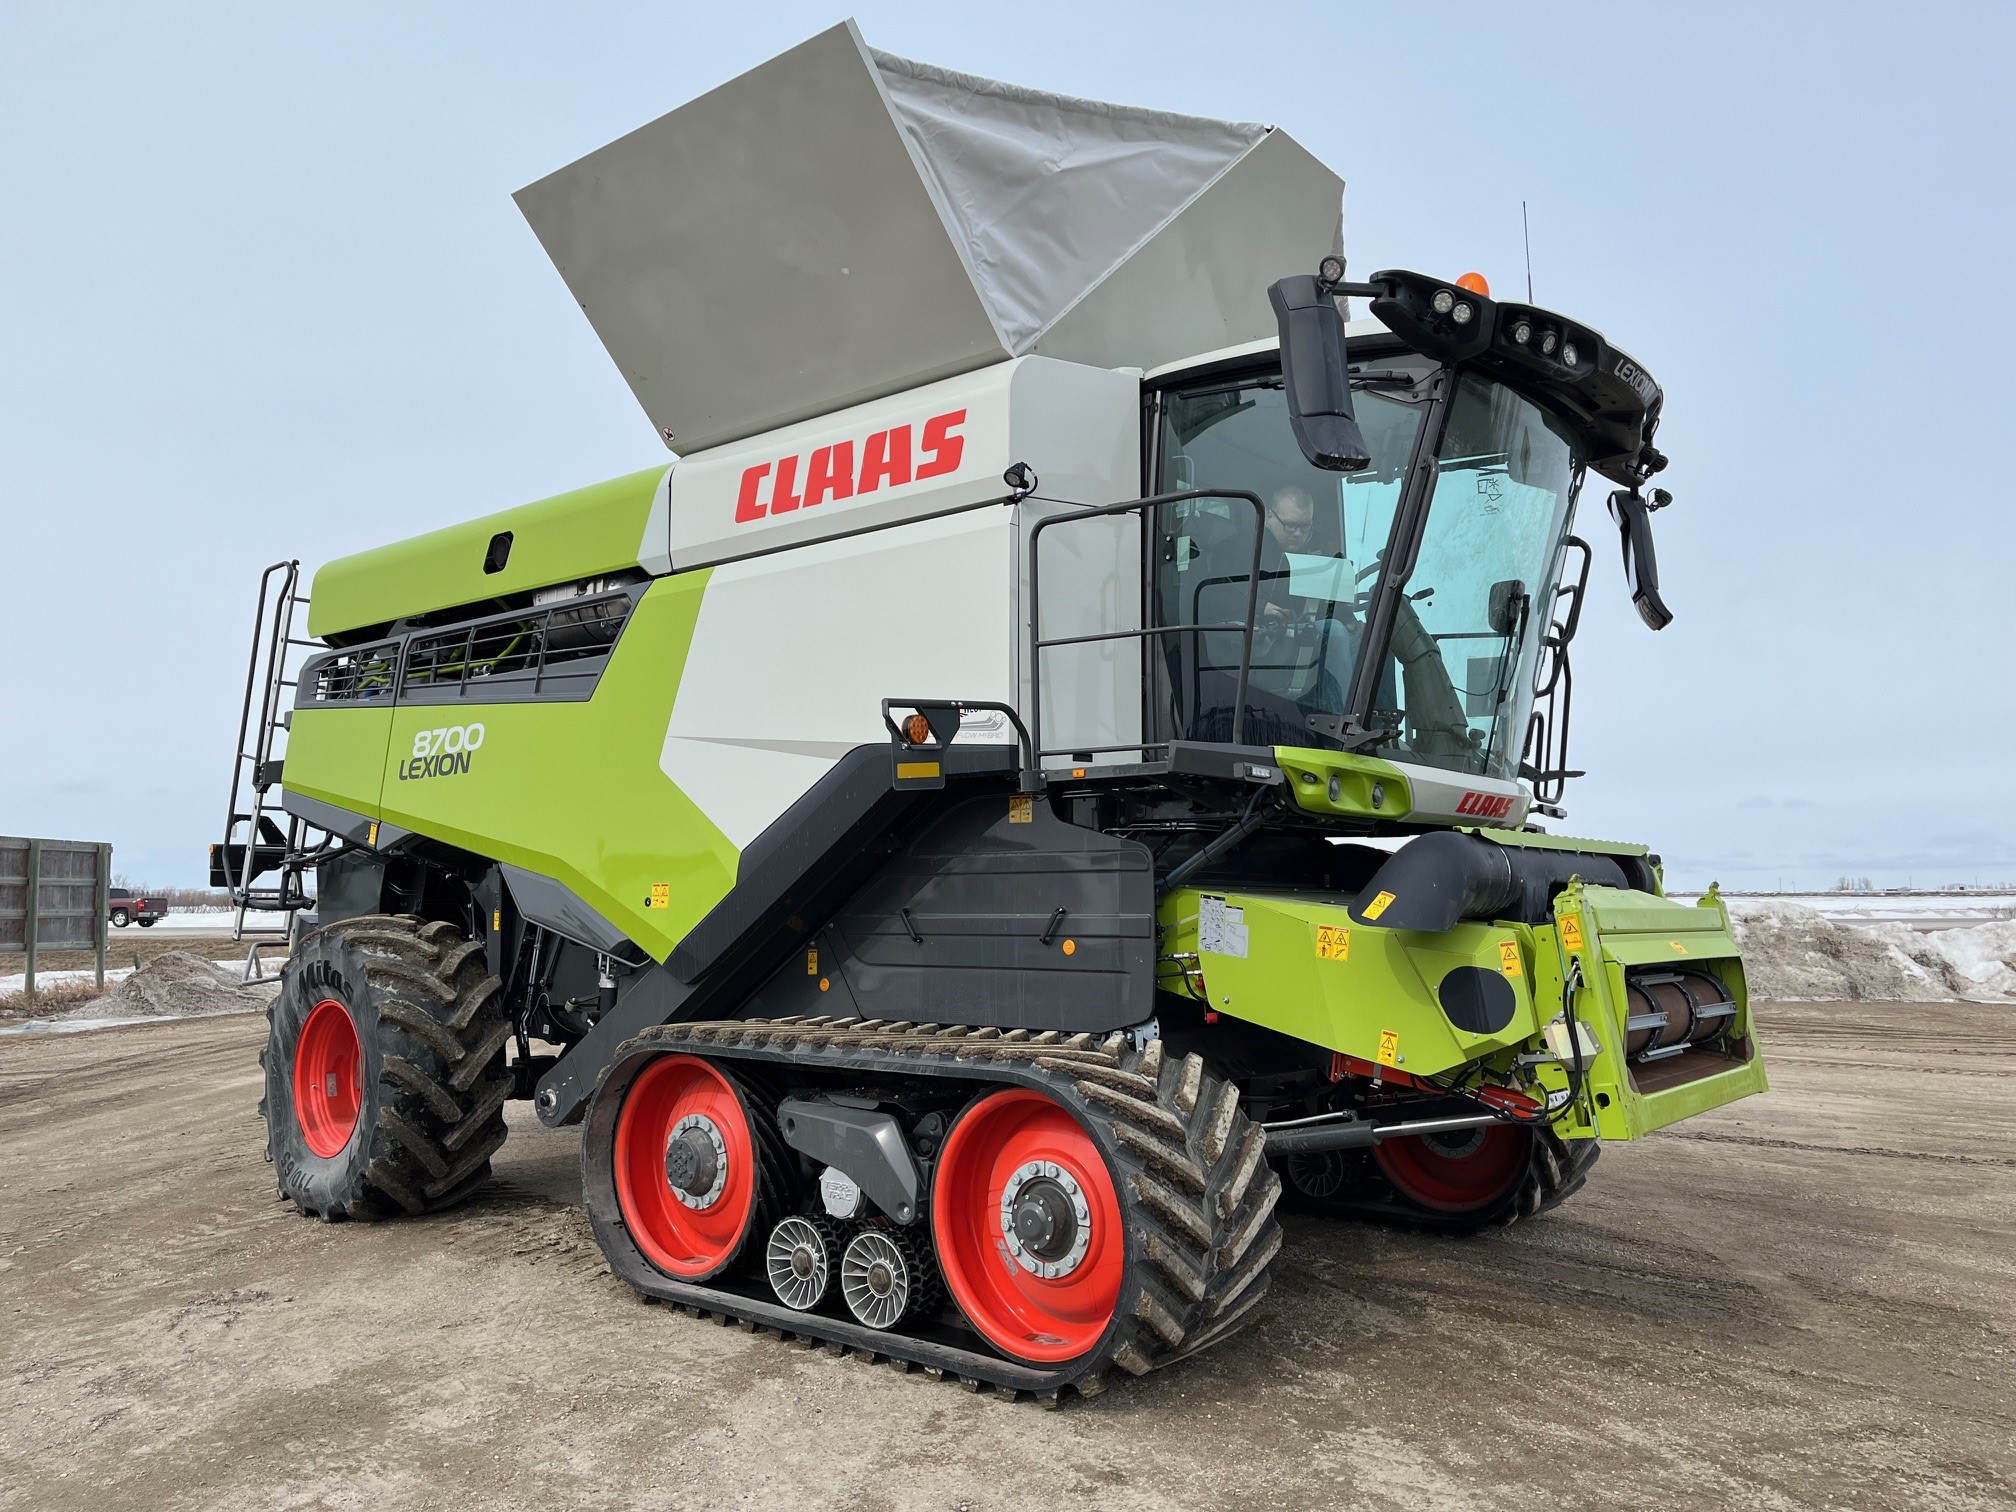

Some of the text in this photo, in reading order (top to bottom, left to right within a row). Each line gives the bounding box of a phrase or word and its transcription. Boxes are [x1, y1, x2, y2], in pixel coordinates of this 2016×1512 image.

[1613, 358, 1653, 398] LEXION
[734, 408, 967, 524] CLAAS
[412, 722, 485, 758] 8700
[399, 751, 472, 781] LEXION
[1455, 791, 1515, 819] CLAAS
[298, 959, 355, 1004] Mitas
[825, 1180, 854, 1192] TERRA
[828, 1189, 854, 1202] TRAC
